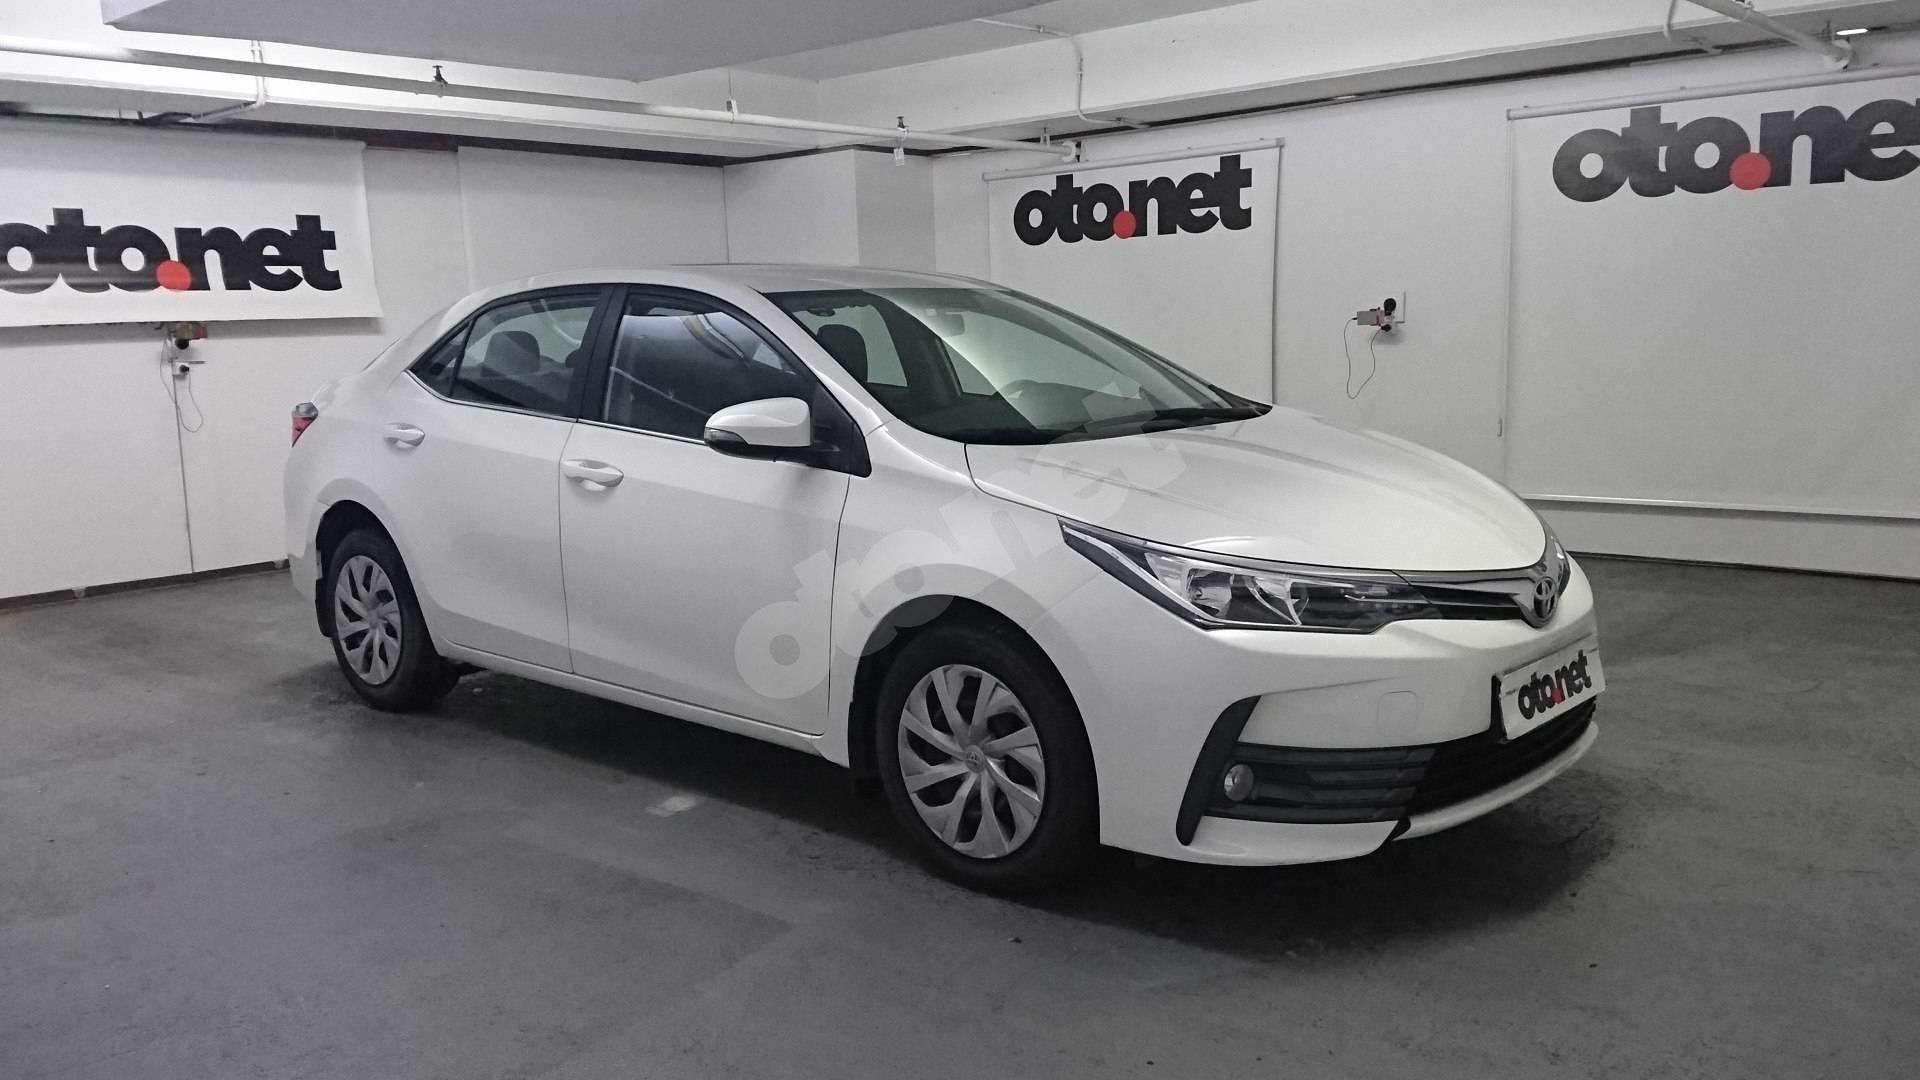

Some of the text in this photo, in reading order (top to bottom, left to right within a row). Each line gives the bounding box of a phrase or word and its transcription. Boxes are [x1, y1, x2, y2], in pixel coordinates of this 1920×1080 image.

[1553, 98, 1920, 202] oto.ne
[1014, 154, 1252, 246] oto.net
[0, 208, 342, 294] oto.net
[1518, 649, 1592, 719] oto.net
